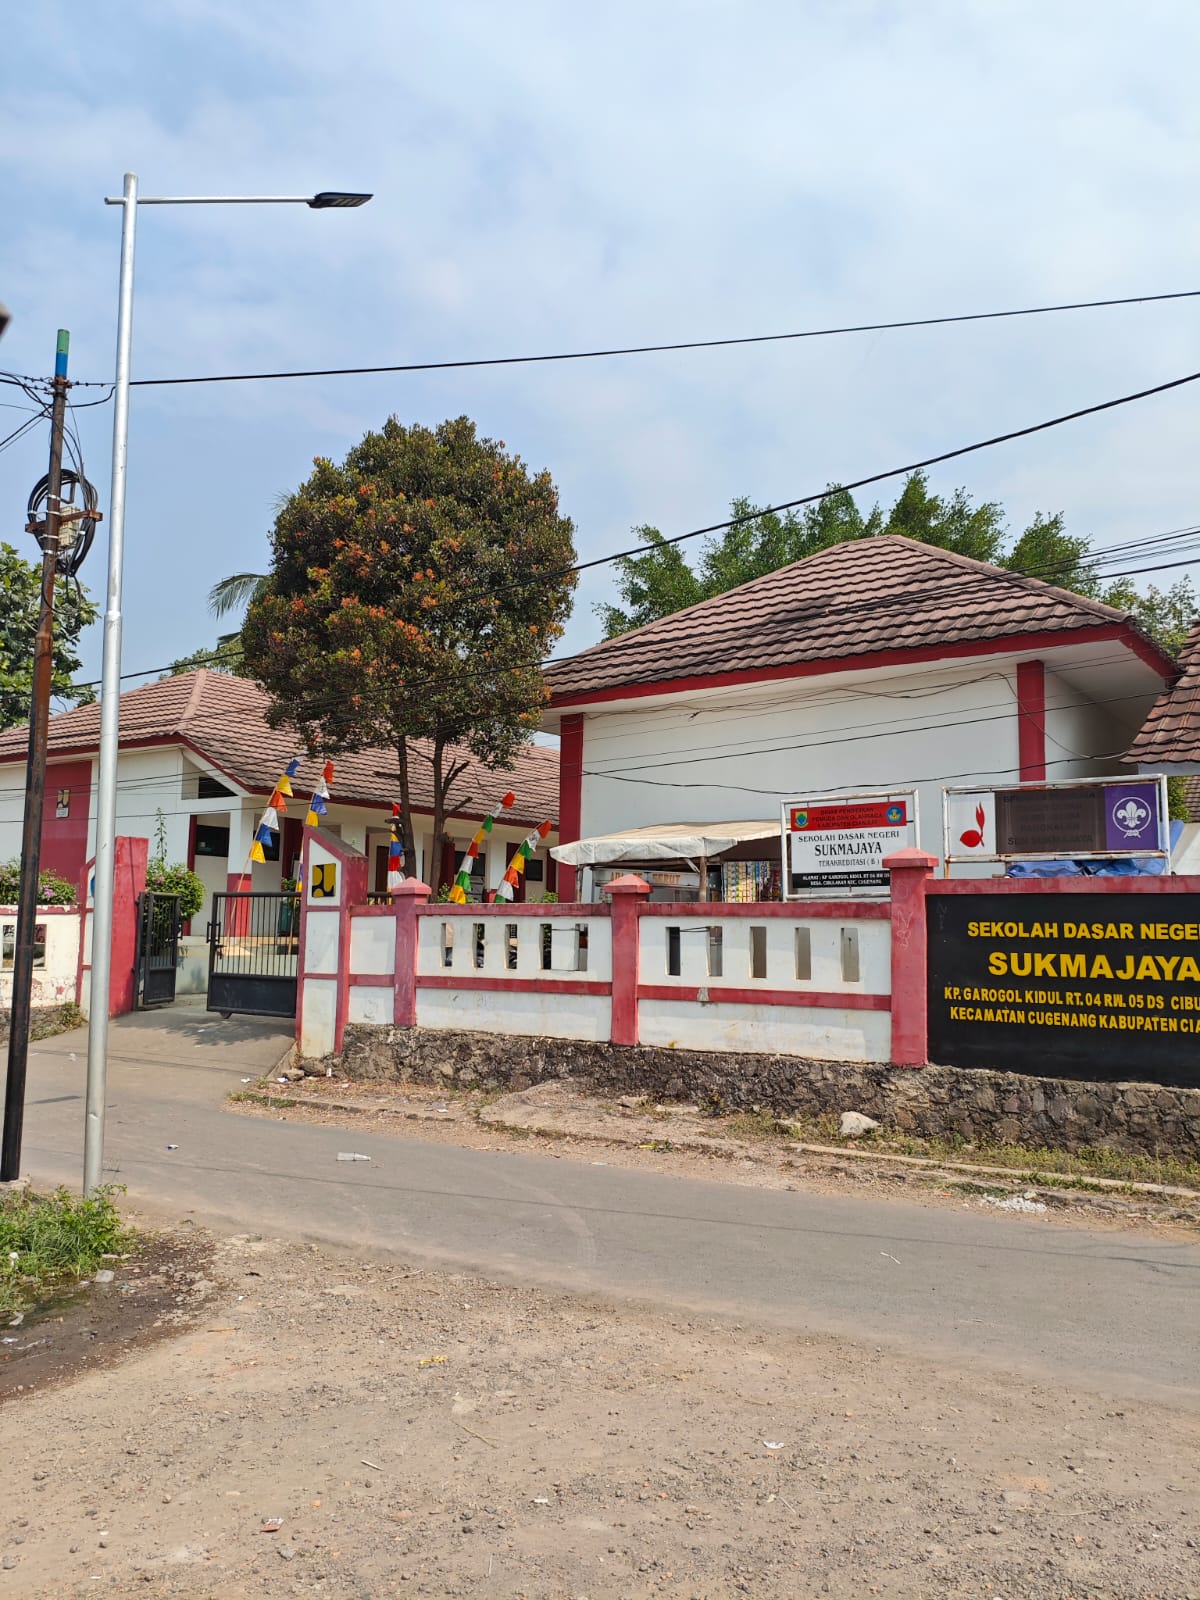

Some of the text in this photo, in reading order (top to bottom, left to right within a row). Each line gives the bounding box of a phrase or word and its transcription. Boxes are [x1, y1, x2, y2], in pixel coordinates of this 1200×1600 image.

[798, 830, 899, 843] SEKOLAH DASAR NEGERI
[814, 841, 882, 857] SUKMAJAYA
[818, 859, 866, 867] TERAKREDITASI
[967, 921, 1200, 940] SEKOLAH DASAR NEGE
[988, 951, 1200, 982] SUKMAJAYA
[944, 986, 961, 1000] KP.
[963, 987, 1022, 1003] GAROGOL
[1024, 990, 1063, 1005] KIDUL
[1065, 991, 1083, 1006] RT.
[1085, 992, 1102, 1007] 04
[1128, 994, 1145, 1009] 05
[1146, 995, 1165, 1010] DS
[950, 1006, 1025, 1024] KECAMATAN
[1027, 1011, 1097, 1028] CUGENANG
[1099, 1014, 1178, 1032] KABUPATEN
